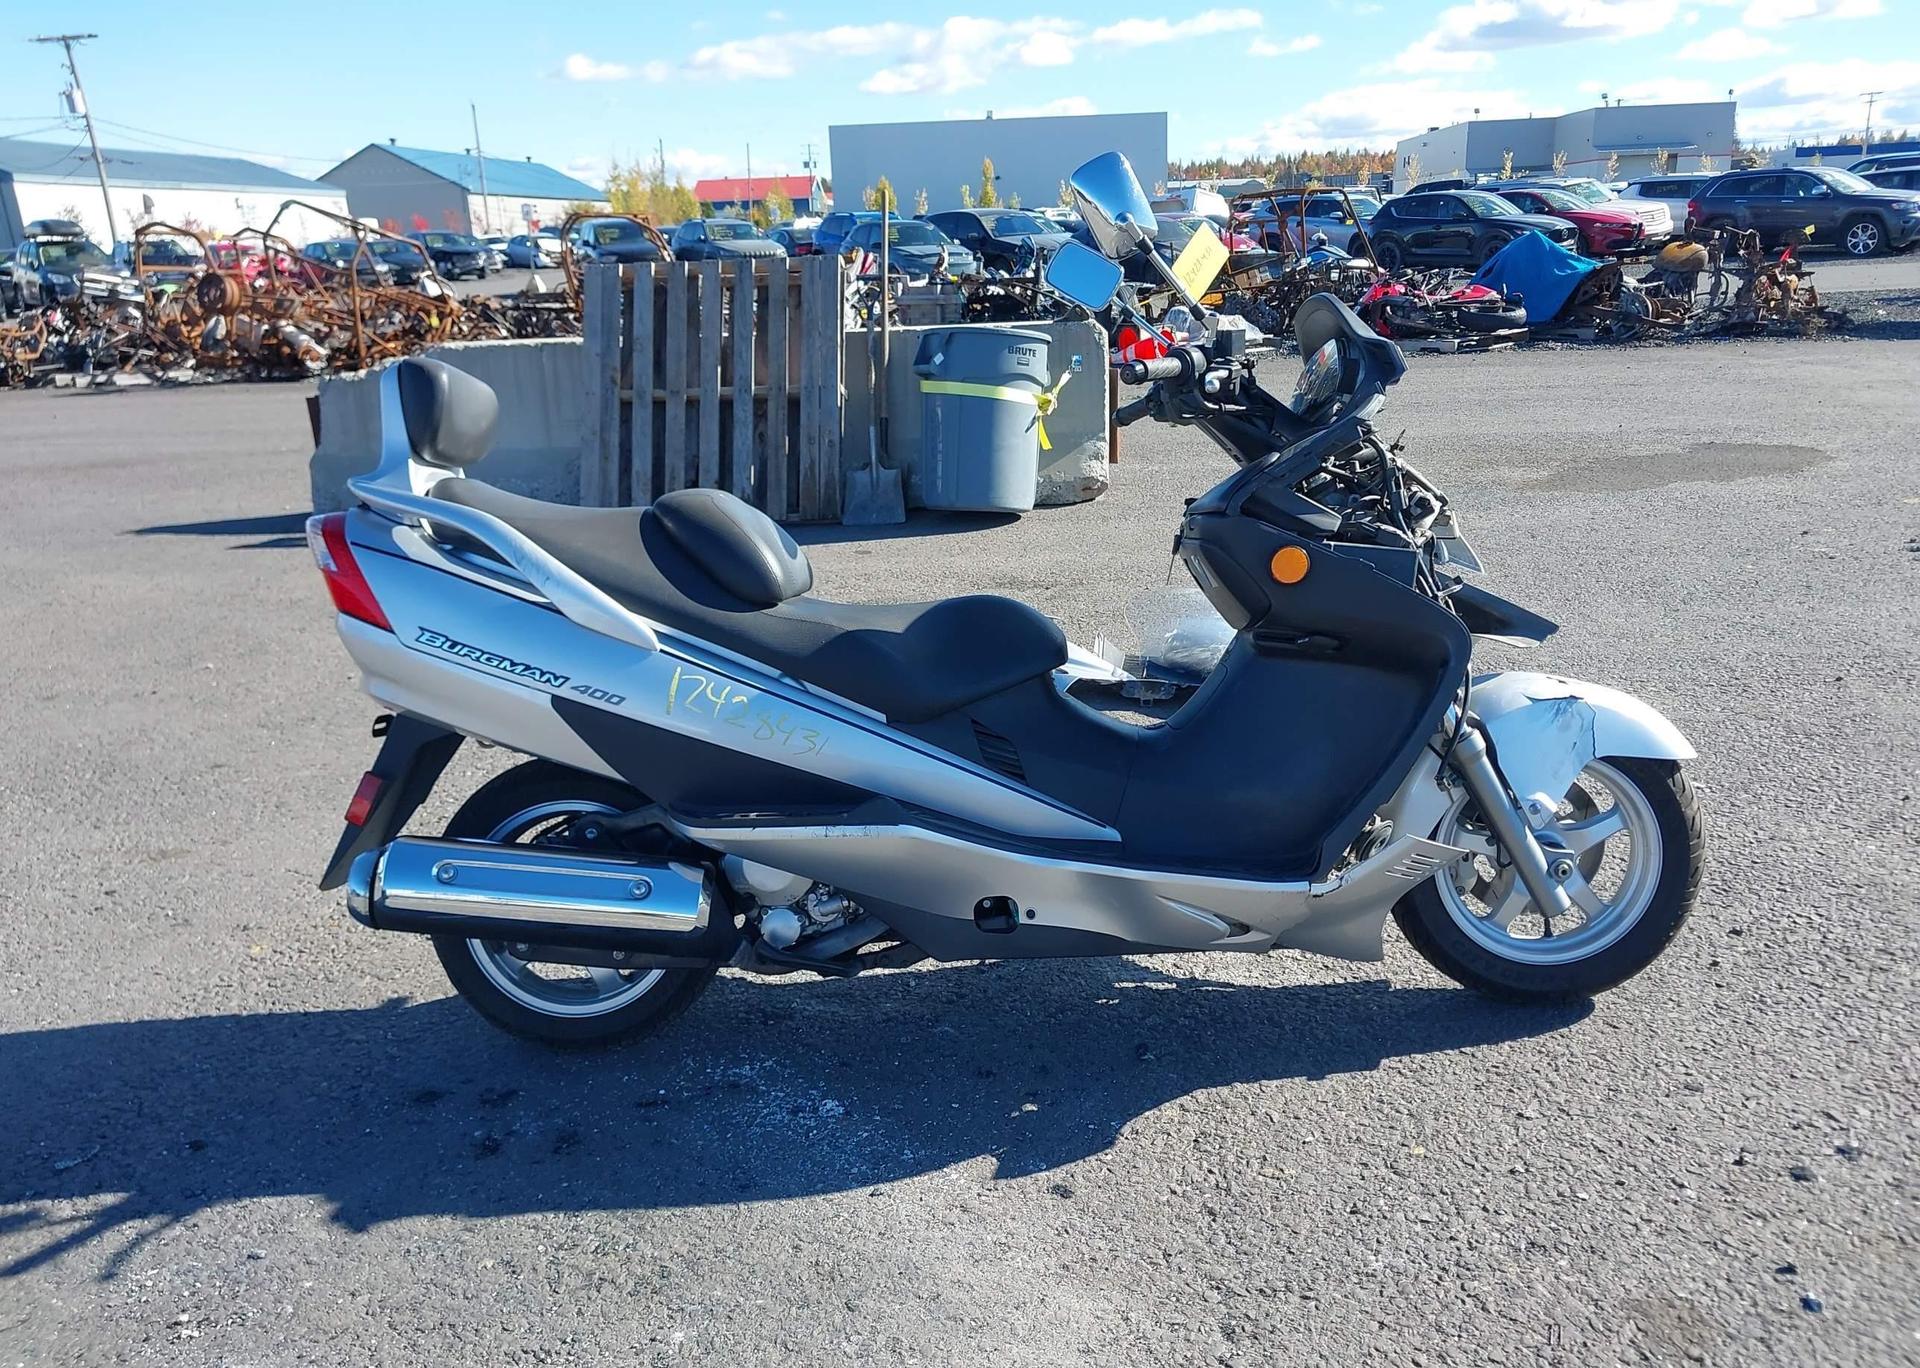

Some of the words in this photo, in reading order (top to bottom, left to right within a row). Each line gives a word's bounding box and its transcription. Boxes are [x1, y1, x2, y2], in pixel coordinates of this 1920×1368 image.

[1008, 345, 1037, 357] BRUTE
[416, 627, 569, 687] BURGMAN
[571, 685, 626, 706] 400
[666, 666, 829, 756] 12428431
